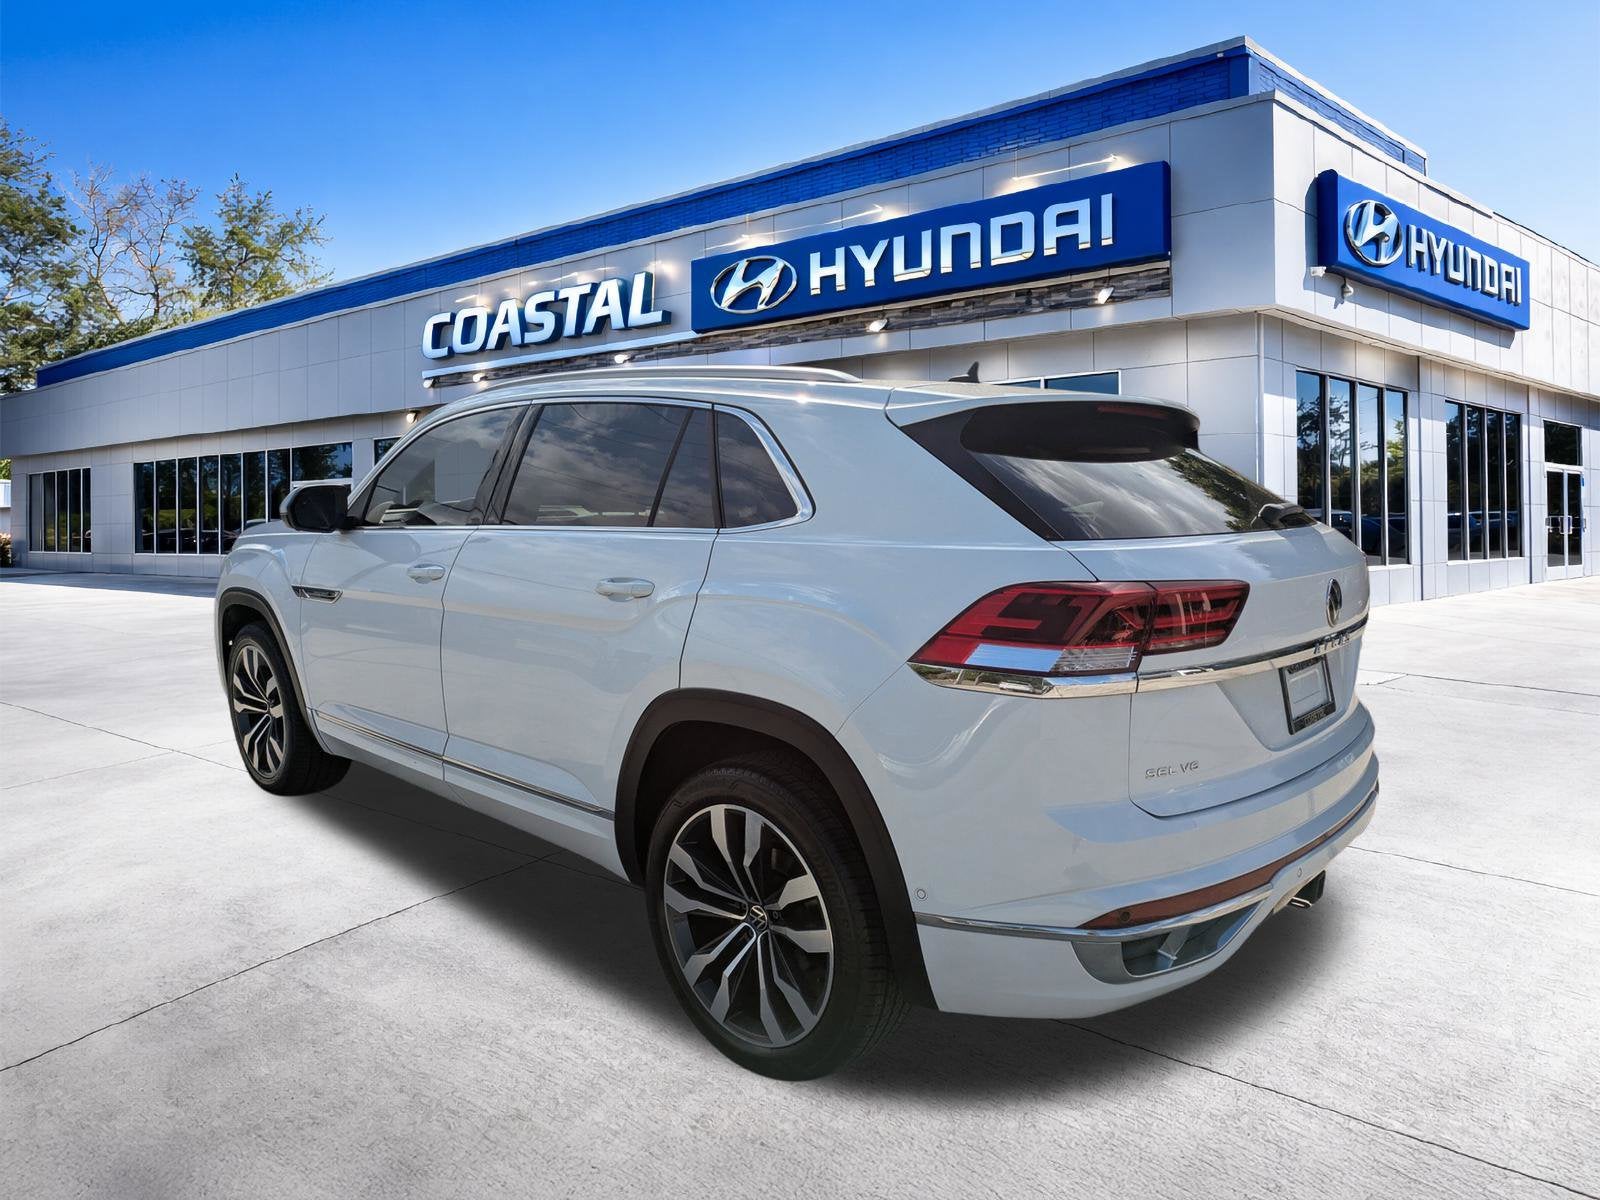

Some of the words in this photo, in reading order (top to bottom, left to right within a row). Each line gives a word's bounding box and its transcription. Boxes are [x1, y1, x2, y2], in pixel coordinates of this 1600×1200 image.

[810, 192, 1113, 296] HYUNDAI
[1407, 224, 1522, 306] HYUNDAI
[422, 271, 667, 359] COASTAL
[1145, 766, 1177, 778] SEL
